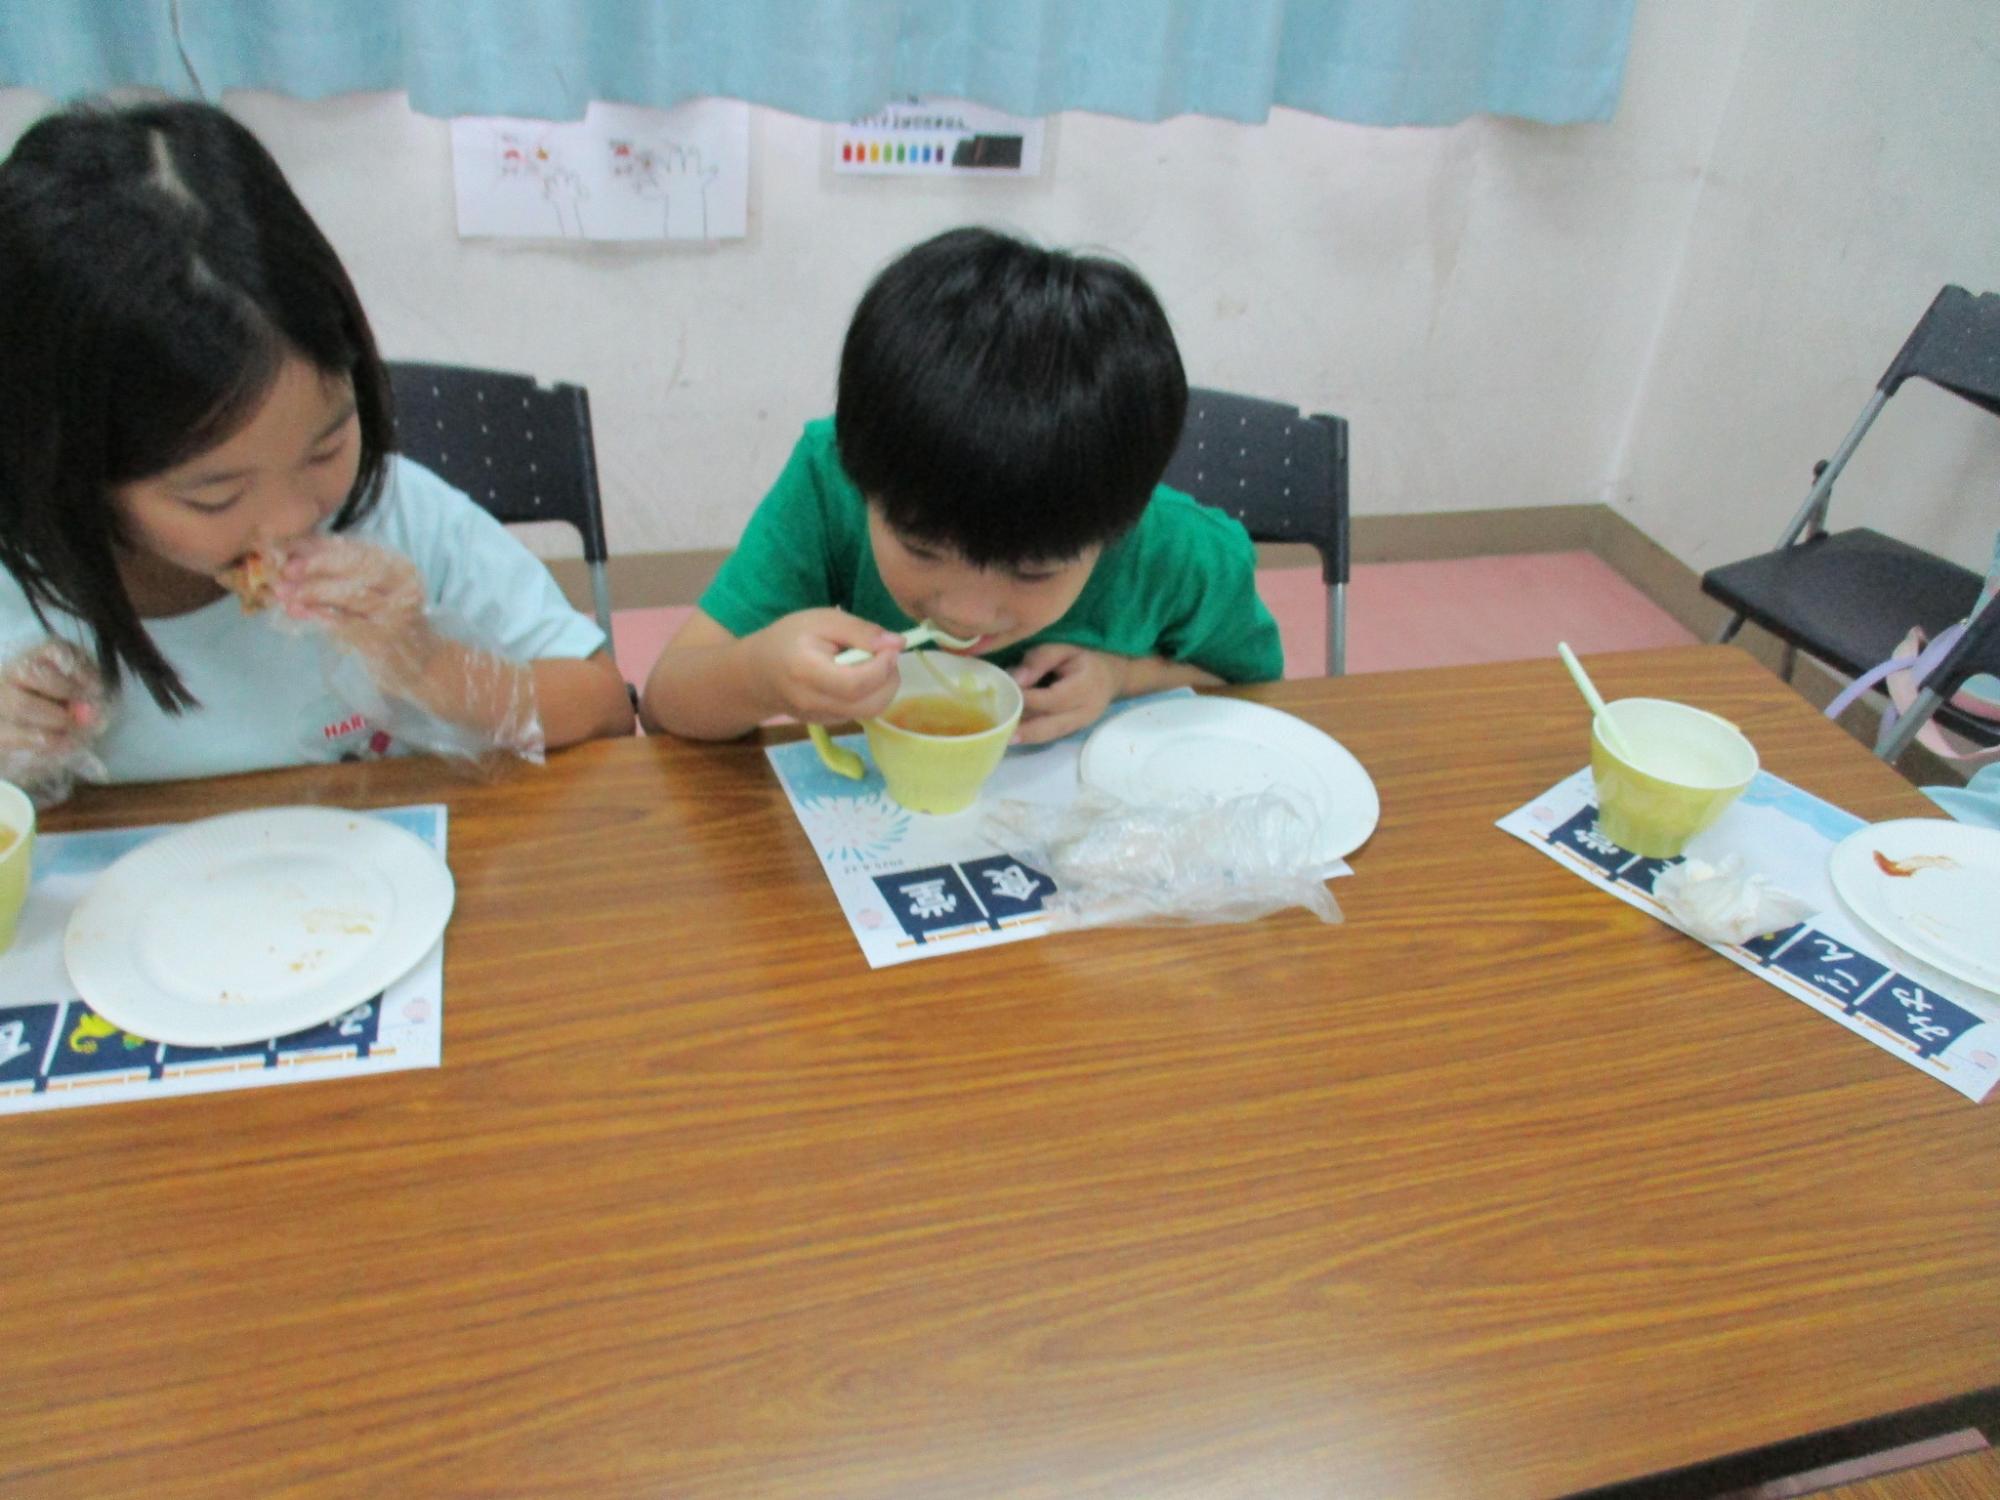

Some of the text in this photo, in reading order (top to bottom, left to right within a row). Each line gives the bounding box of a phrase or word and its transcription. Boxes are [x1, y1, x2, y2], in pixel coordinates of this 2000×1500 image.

[898, 864, 1041, 920] 食堂
[1813, 938, 1950, 1043] みやごん
